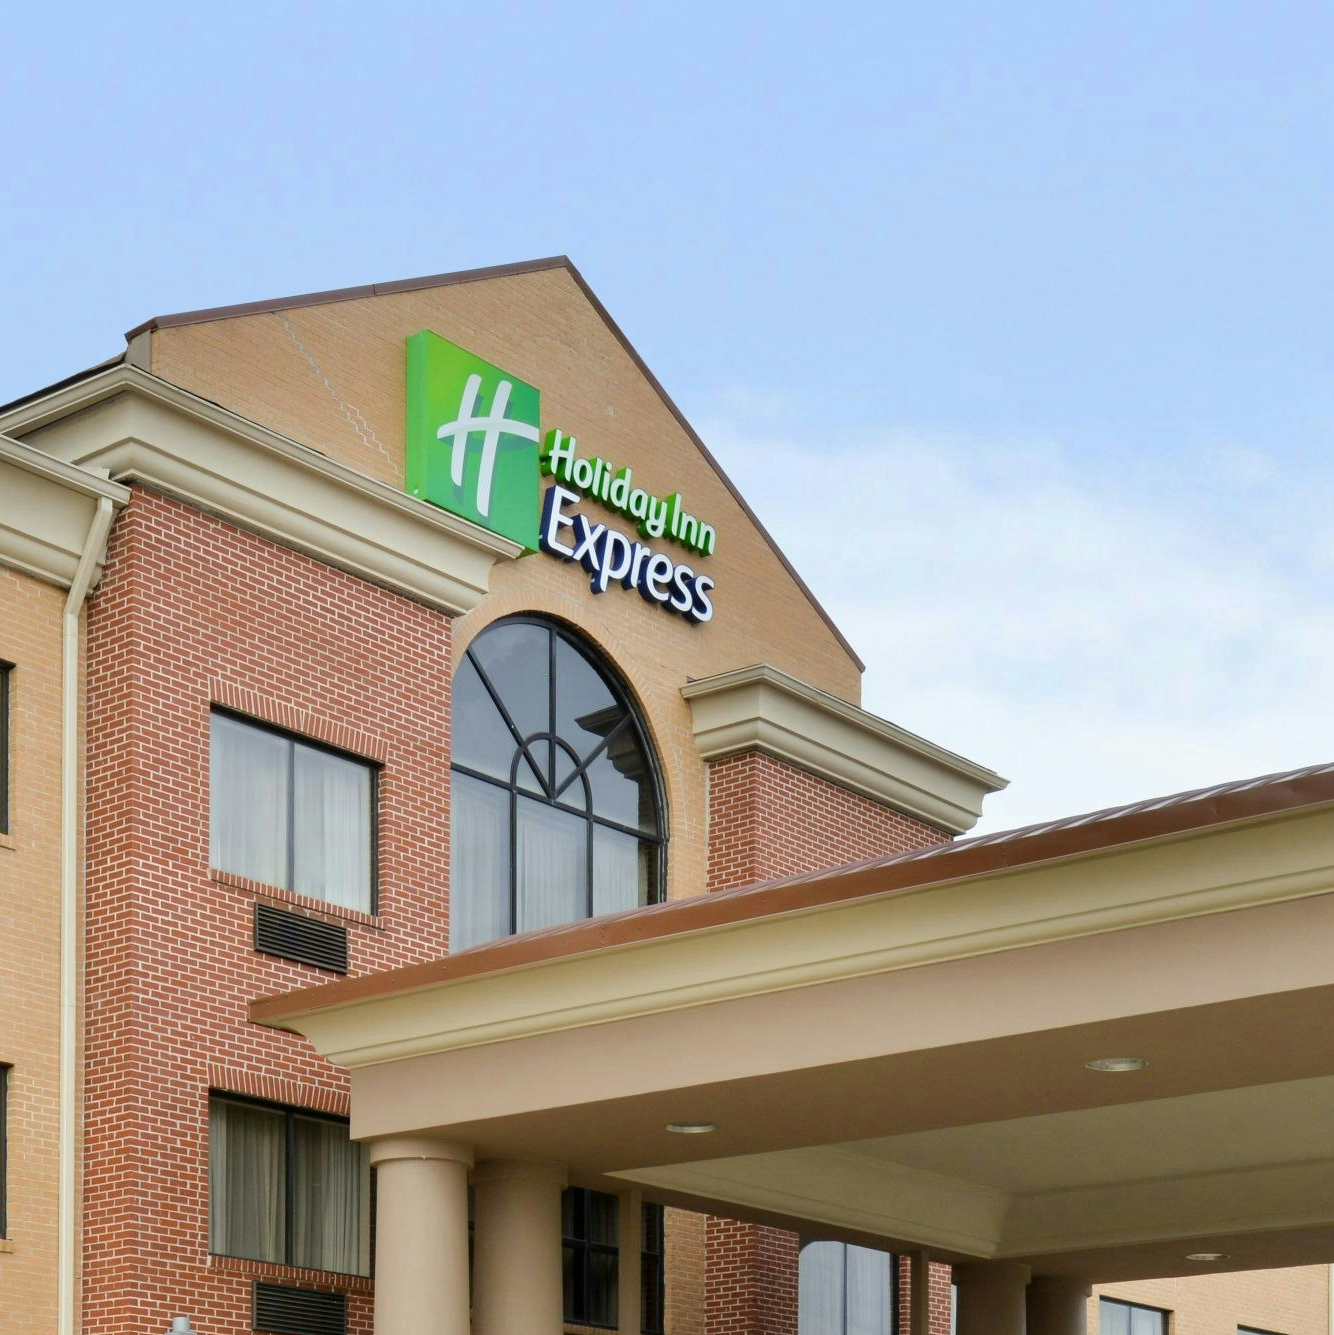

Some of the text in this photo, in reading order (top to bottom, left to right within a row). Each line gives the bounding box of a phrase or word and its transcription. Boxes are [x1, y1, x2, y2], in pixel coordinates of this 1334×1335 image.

[437, 373, 539, 517] H
[547, 428, 715, 555] Holiday Inn
[546, 485, 714, 623] Express
